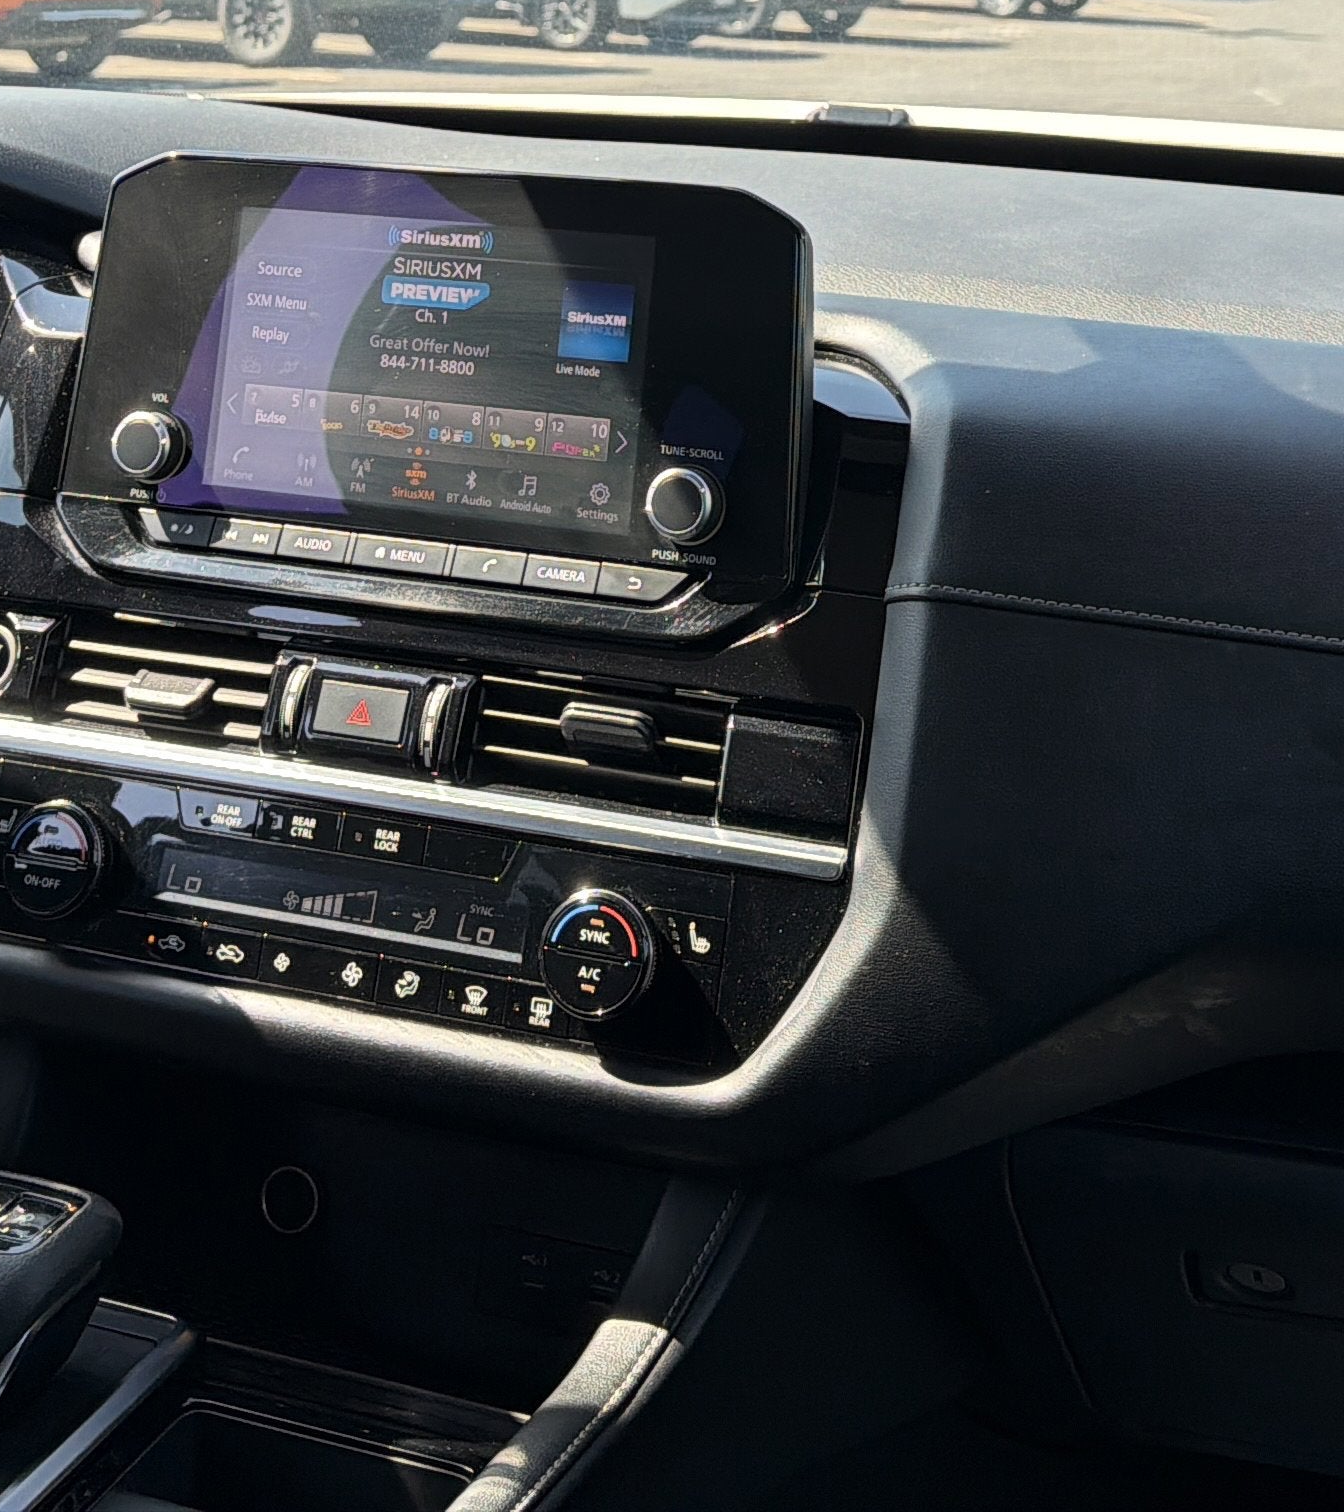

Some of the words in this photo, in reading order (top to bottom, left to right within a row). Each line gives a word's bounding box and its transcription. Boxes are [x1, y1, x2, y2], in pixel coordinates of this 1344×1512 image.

[257, 261, 303, 278] Source
[393, 257, 482, 280] SIRIUSXM
[390, 282, 480, 303] PREVIEW
[246, 292, 273, 308] SXM
[275, 295, 307, 311] Menu
[415, 309, 438, 324] Ch.
[442, 310, 449, 325] 1
[567, 311, 627, 327] SiriusXM
[252, 325, 290, 345] Replay
[369, 335, 408, 352] Great
[415, 338, 449, 355] Offer
[453, 342, 491, 359] Now!
[380, 354, 475, 376] 844-711-8800
[556, 363, 573, 376] Live
[575, 365, 601, 378] Mode
[152, 392, 169, 404] VOL
[291, 395, 301, 409] 5
[350, 400, 360, 414] 6
[368, 403, 376, 414] 9
[404, 405, 420, 419] 14
[428, 409, 440, 421] 10
[472, 411, 482, 425] 8
[488, 416, 501, 427] 11
[534, 418, 544, 432] 9
[552, 421, 564, 434] 12
[591, 424, 608, 439] 10
[224, 469, 254, 482] Phone
[295, 478, 313, 488] AM
[350, 482, 366, 494] FM
[392, 488, 436, 502] SiriusXM
[447, 492, 458, 504] BT
[461, 494, 492, 508] Audio
[500, 499, 532, 513] Android
[533, 501, 552, 514] Auto
[576, 507, 619, 523] Settings
[295, 537, 332, 552] AUDIO
[390, 550, 425, 564] MENU
[652, 549, 680, 562] PUSH
[682, 552, 717, 567] SOUND
[537, 566, 586, 583] CAMERA
[216, 803, 241, 816] REAR
[292, 815, 317, 828] REAR
[290, 827, 313, 840] CTRL
[375, 828, 401, 842] REAR
[34, 838, 63, 850] AUTO
[374, 840, 399, 853] LOCK
[166, 863, 202, 894] Lo
[469, 904, 494, 917] SYNC
[457, 913, 495, 945] Lo
[579, 928, 611, 945] SYNC
[577, 965, 602, 982] A/C
[461, 1003, 488, 1017] FRONT
[528, 1016, 550, 1029] REAR
